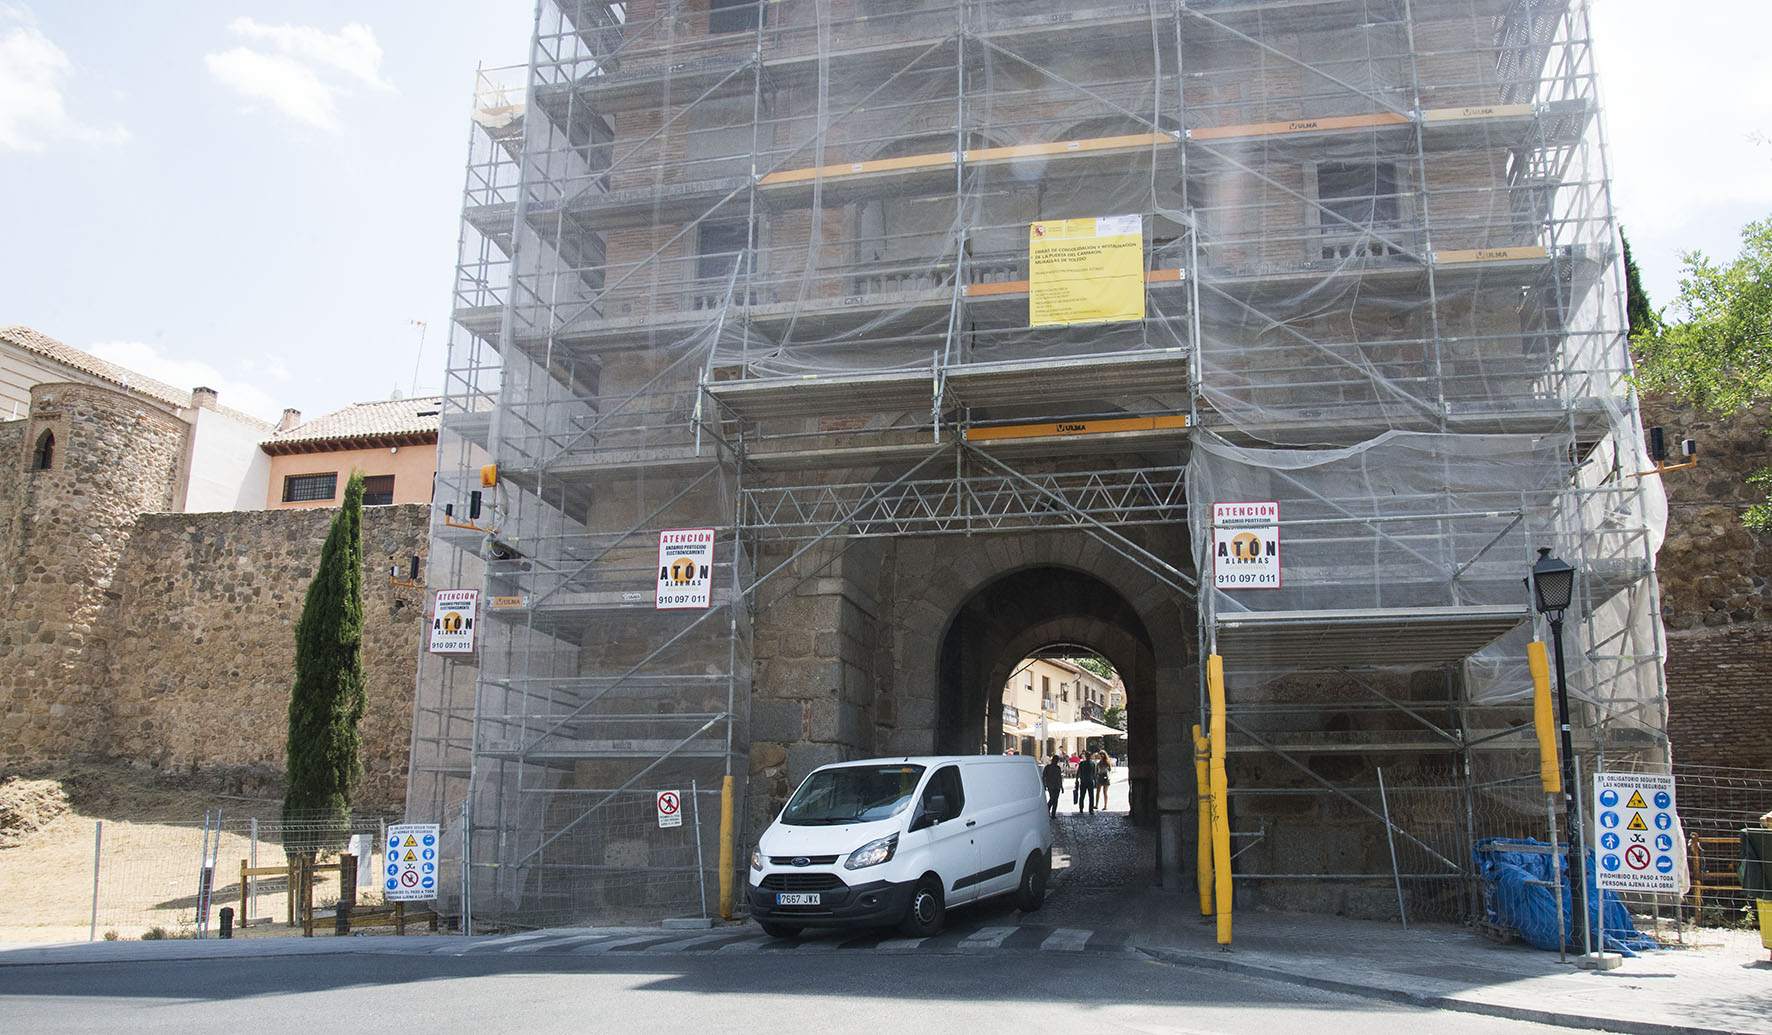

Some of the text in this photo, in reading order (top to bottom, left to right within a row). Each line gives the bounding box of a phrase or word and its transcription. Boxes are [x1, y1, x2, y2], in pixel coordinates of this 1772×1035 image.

[1218, 506, 1274, 516] ATENCIÓN
[663, 532, 711, 543] ATENCIÓN
[1218, 538, 1276, 557] ATÓN
[660, 563, 709, 580] ATÓN
[1219, 574, 1236, 583] 910
[1239, 574, 1256, 582] 097
[434, 615, 472, 629] ATÓN
[781, 895, 818, 903] 7667 JWX
